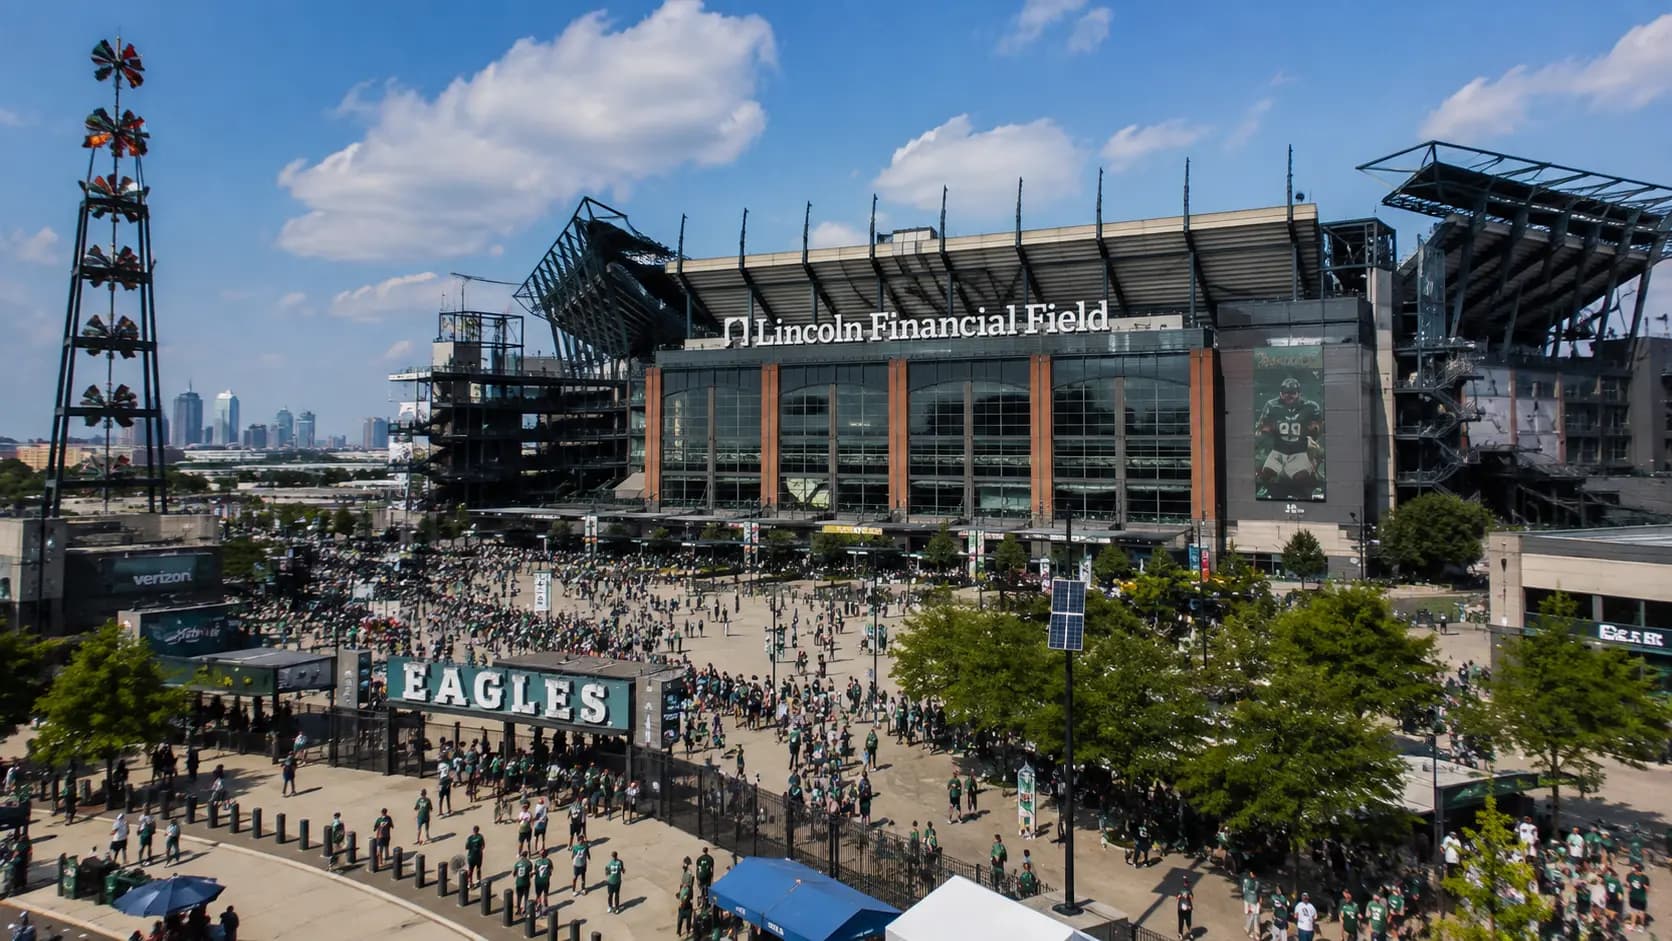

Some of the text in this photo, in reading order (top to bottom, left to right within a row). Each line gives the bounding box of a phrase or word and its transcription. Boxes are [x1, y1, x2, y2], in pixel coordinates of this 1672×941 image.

[756, 300, 1110, 346] Lincoln Financial Field
[133, 570, 193, 585] verizon
[402, 662, 607, 724] EAGLES
